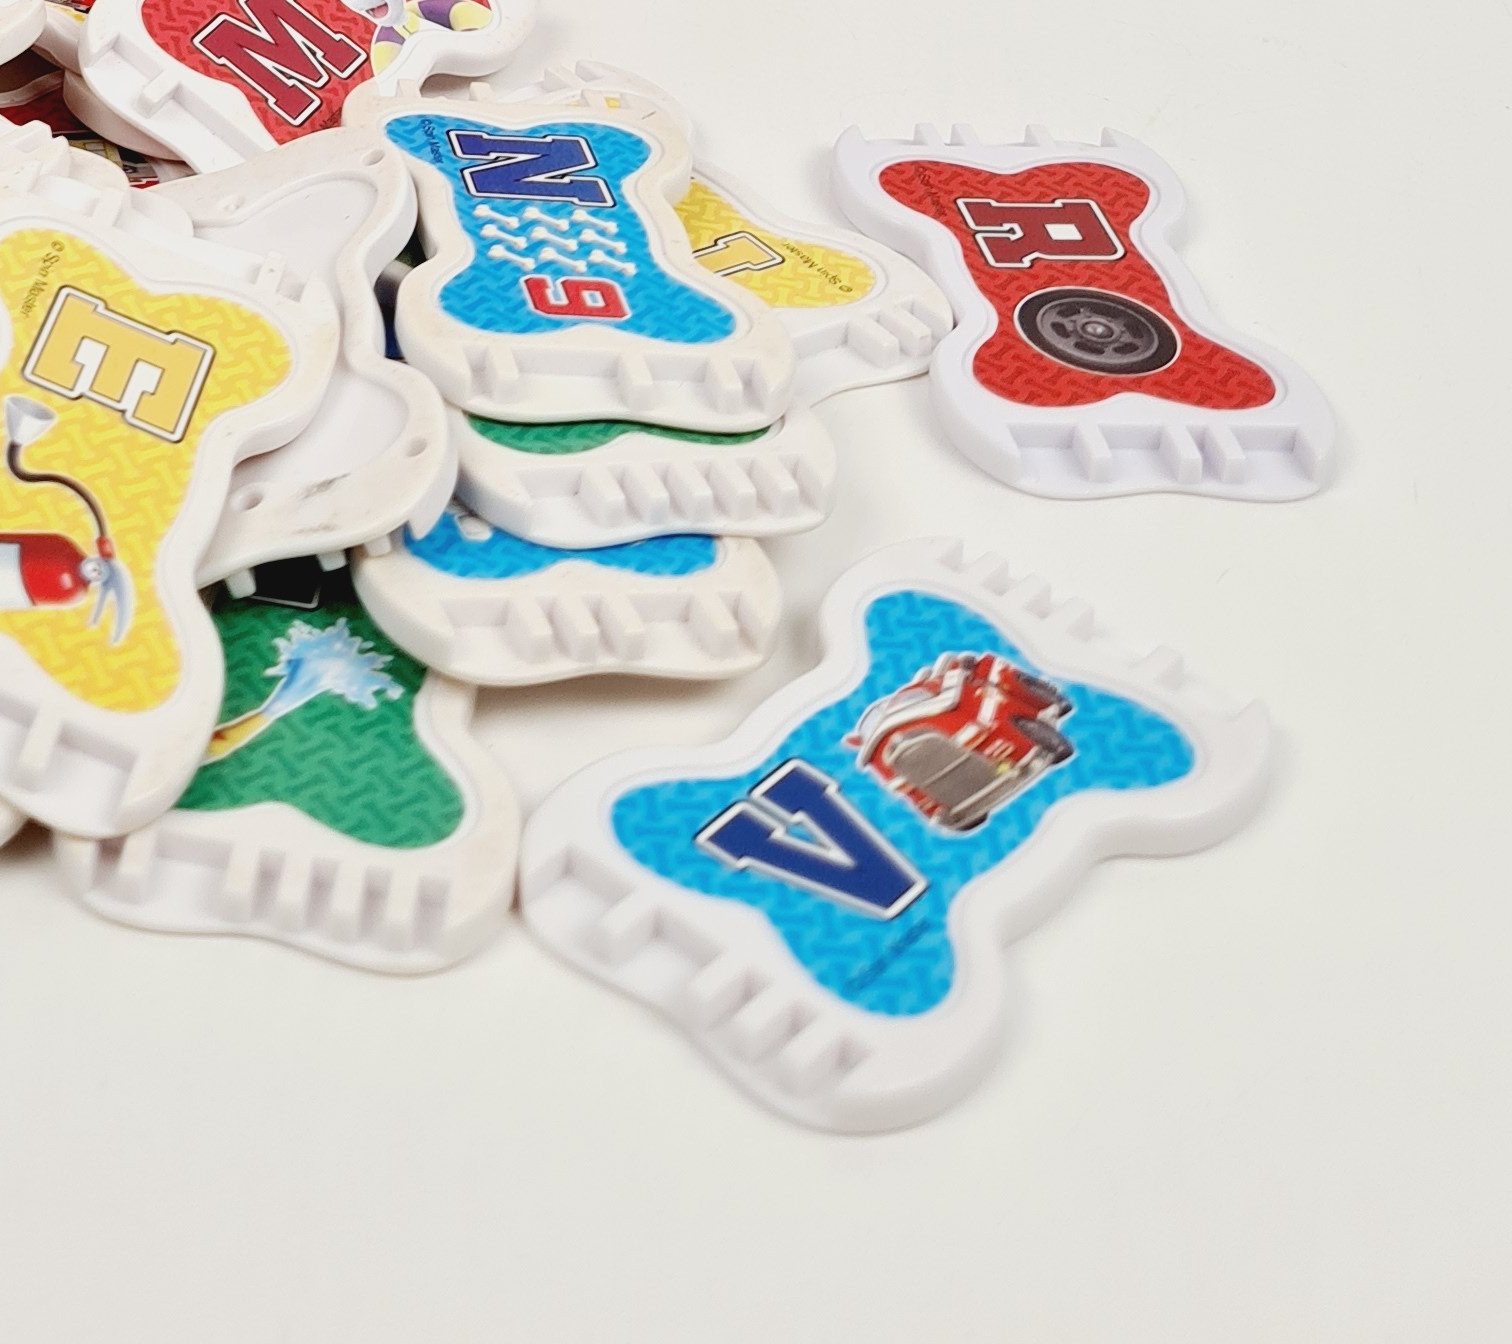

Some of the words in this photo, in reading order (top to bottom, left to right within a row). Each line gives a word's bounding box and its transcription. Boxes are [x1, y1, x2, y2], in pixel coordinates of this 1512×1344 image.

[445, 128, 618, 209] N
[955, 197, 1127, 270] R
[20, 283, 217, 444] E
[692, 755, 932, 921] V
